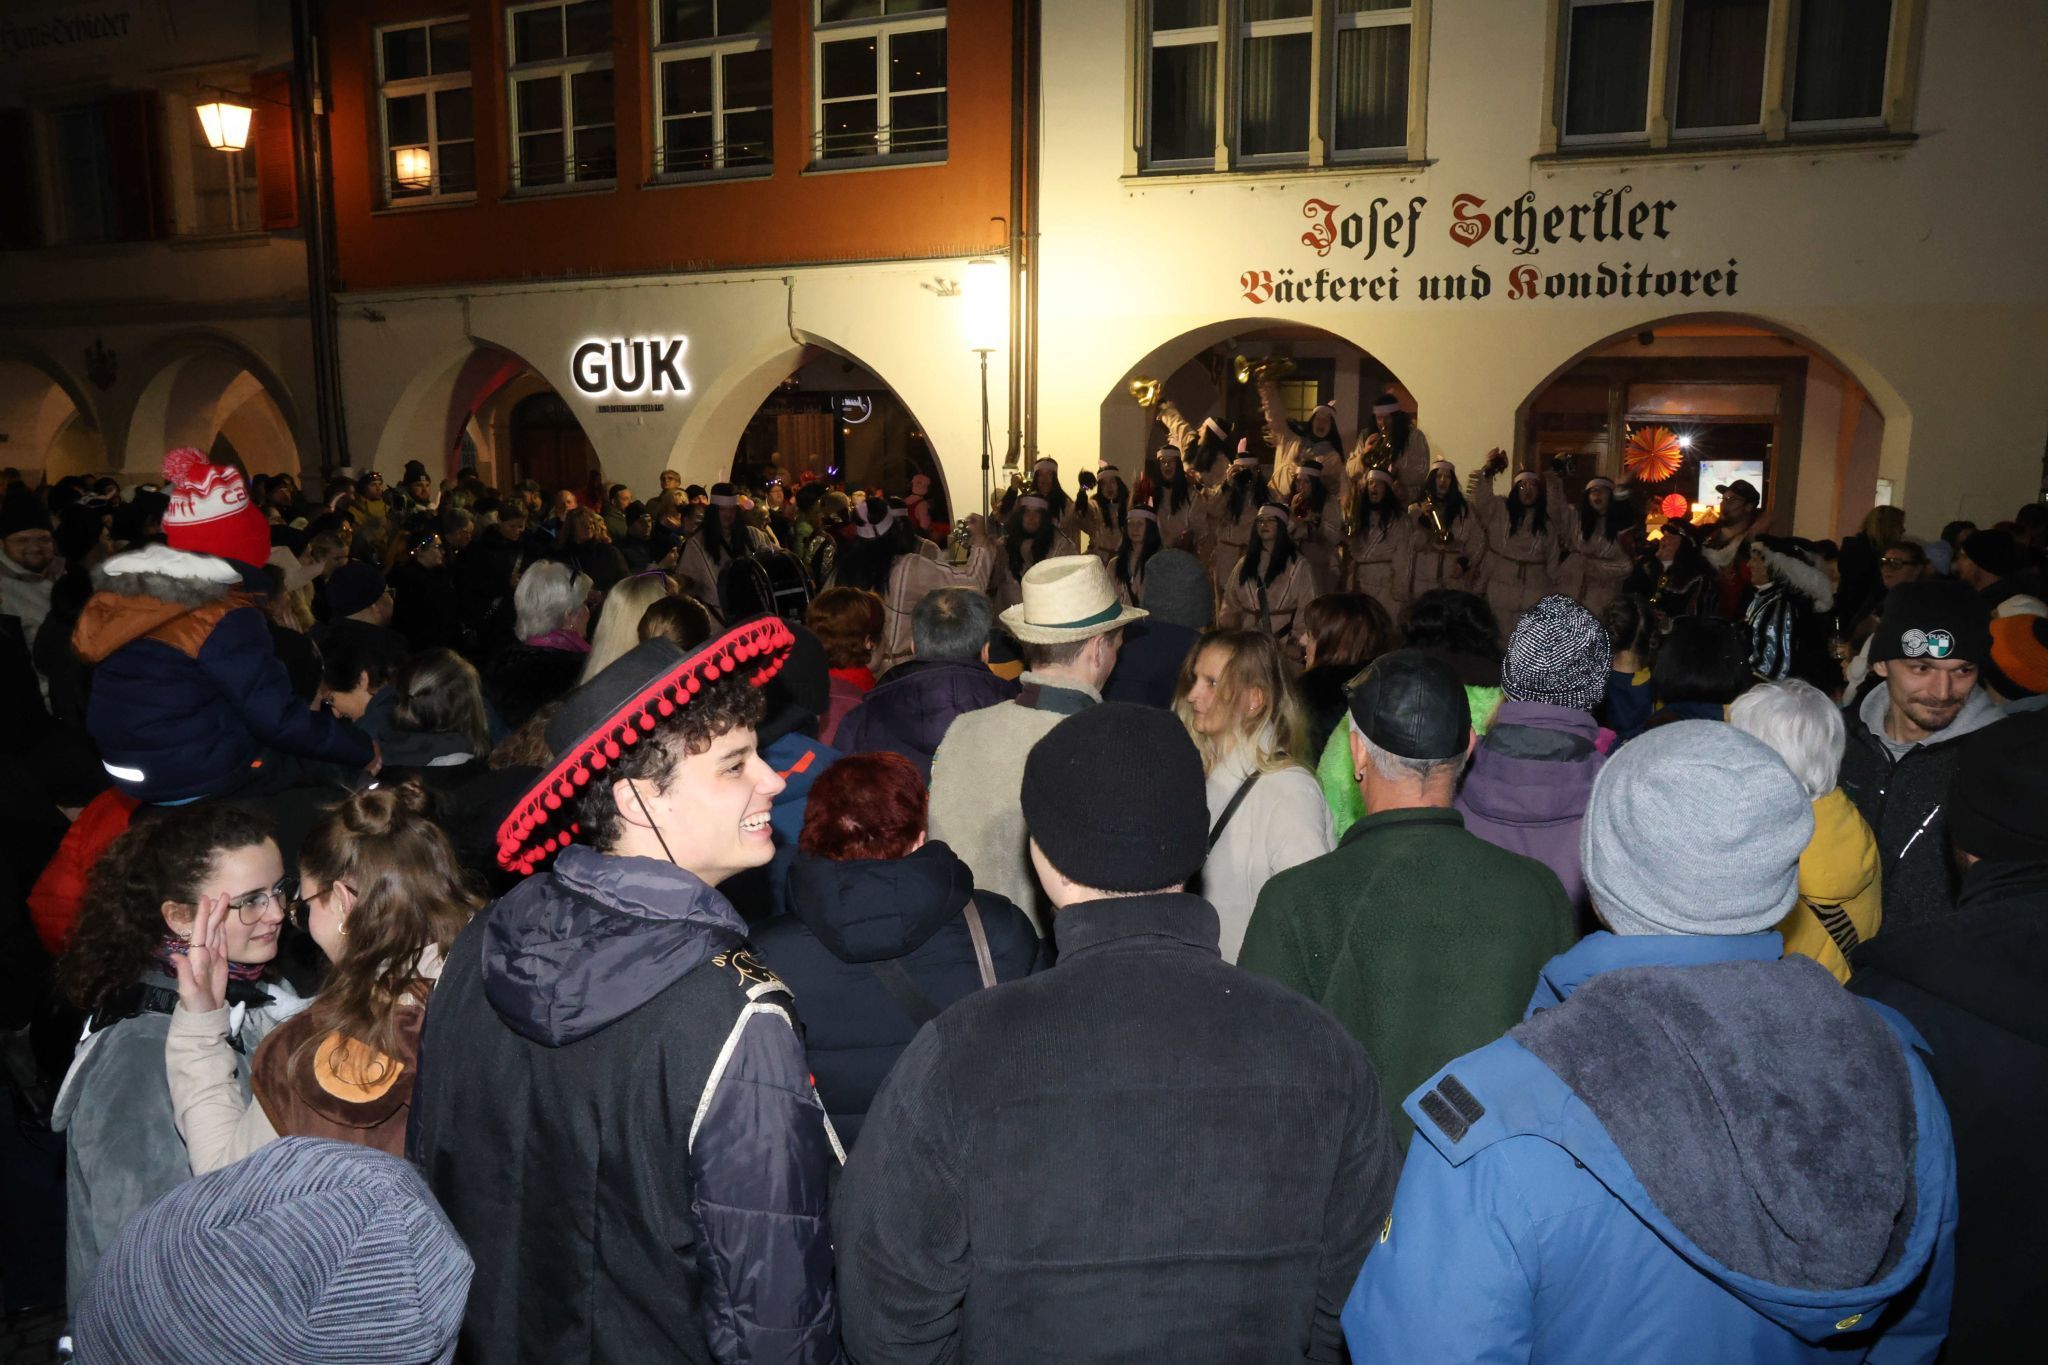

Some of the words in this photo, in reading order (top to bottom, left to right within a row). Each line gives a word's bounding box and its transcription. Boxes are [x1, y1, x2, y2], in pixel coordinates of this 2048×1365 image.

[1301, 196, 1428, 260] Josef
[1449, 184, 1677, 255] Schertler
[1240, 266, 1399, 305] Bäckerei
[1418, 264, 1491, 301] und
[1507, 257, 1739, 301] Konditorei
[572, 339, 686, 393] GUK
